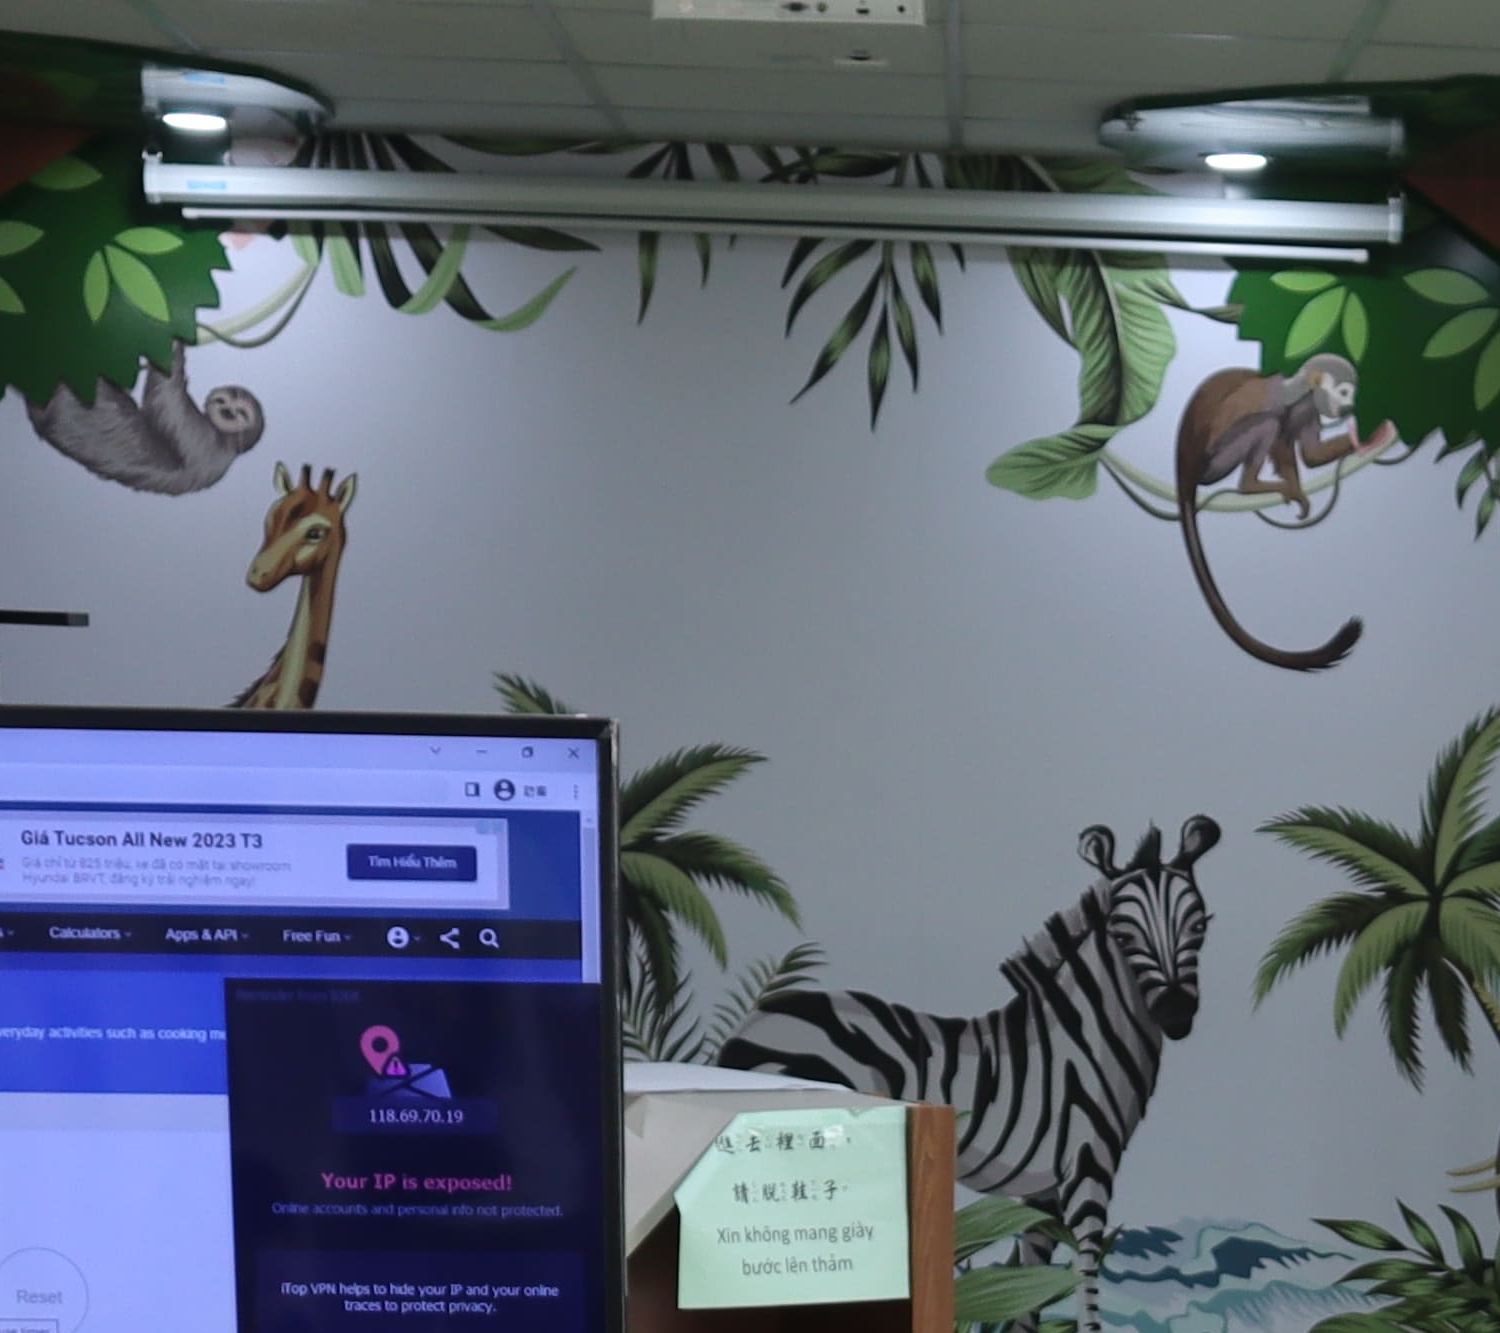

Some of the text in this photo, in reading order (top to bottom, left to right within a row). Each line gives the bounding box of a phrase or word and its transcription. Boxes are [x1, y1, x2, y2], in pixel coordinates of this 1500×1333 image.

[21, 830, 264, 848] Giá Tucson All New 2023 T3
[50, 926, 120, 940] Calculators
[166, 928, 238, 943] Apps API
[283, 929, 340, 943] Free Fun
[48, 1026, 101, 1040] activities
[106, 1027, 136, 1040] such
[139, 1030, 155, 1040] as
[158, 1028, 206, 1044] cooking
[370, 1109, 463, 1124] 118.69.70.19
[322, 1172, 512, 1194] Your IP is exposed!
[717, 1222, 875, 1246] Xin không mang giày
[742, 1254, 853, 1276] bước lên thảm
[16, 1289, 63, 1304] Reset
[280, 1282, 559, 1300] iTop VPN helps to hide your IP and your online
[344, 1300, 497, 1316] traces to protect privacy.
